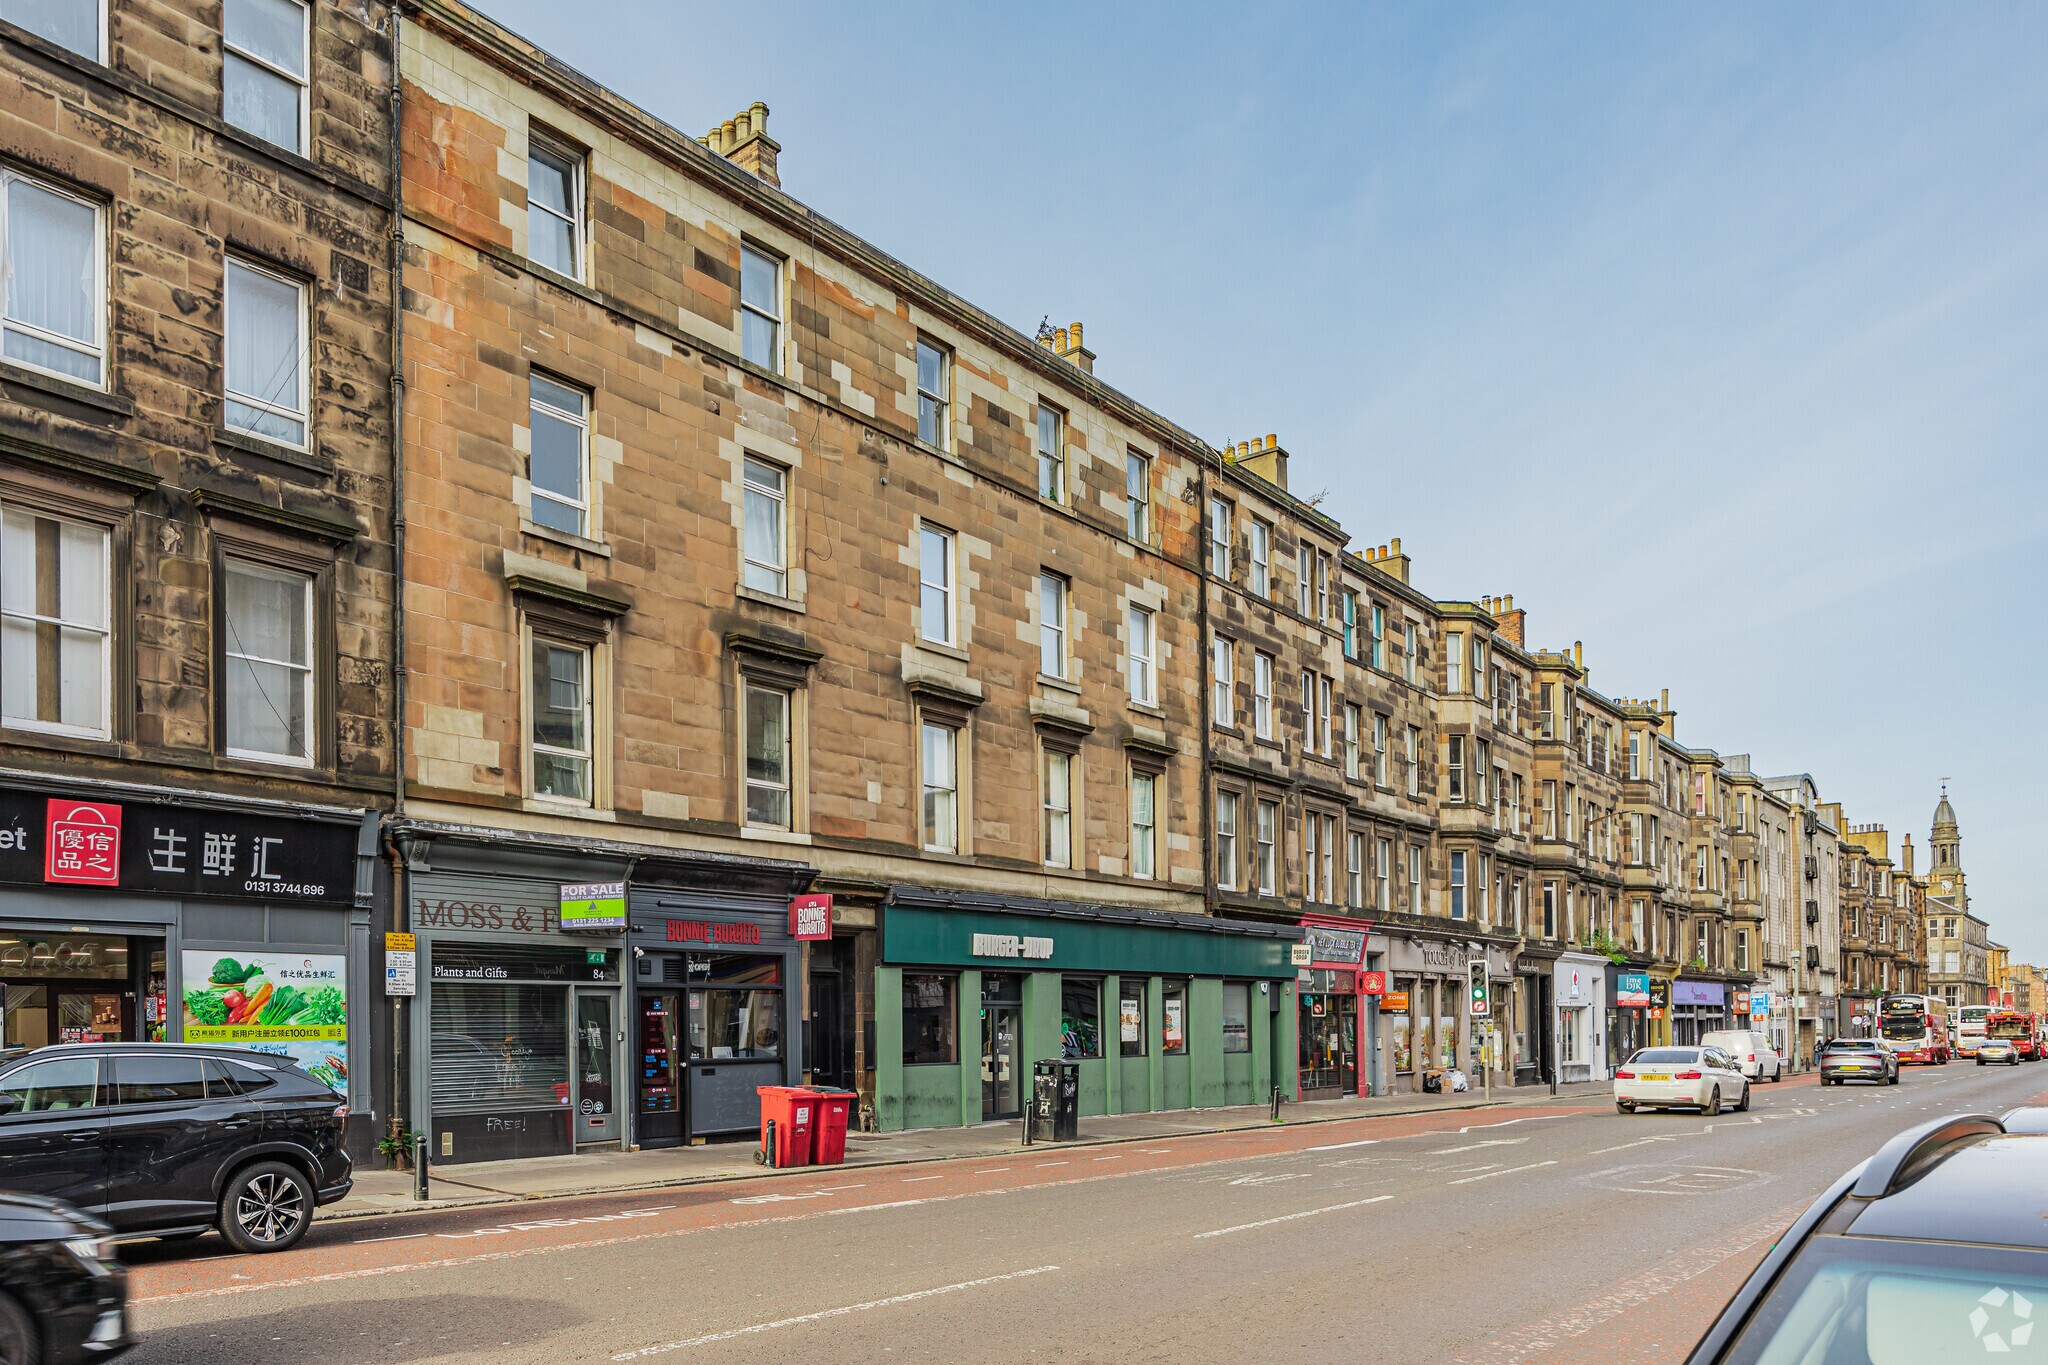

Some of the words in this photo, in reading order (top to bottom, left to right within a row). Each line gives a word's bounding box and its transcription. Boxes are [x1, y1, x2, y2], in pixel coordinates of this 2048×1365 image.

[152, 827, 284, 880] 生鲜汇
[244, 881, 270, 892] 0131
[272, 882, 301, 894] 3744
[303, 884, 325, 896] 696
[561, 885, 587, 896] FOR
[591, 884, 624, 895] SALE
[418, 899, 503, 930] MOSS
[511, 906, 534, 932] &
[713, 922, 761, 945] BURRITO
[797, 920, 826, 935] BURRITO
[1424, 950, 1449, 965] TOUCH
[434, 966, 464, 978] Plants
[465, 967, 483, 978] and
[485, 967, 508, 979] Gifts
[593, 969, 604, 980] 84
[486, 1116, 527, 1132] FREE!
